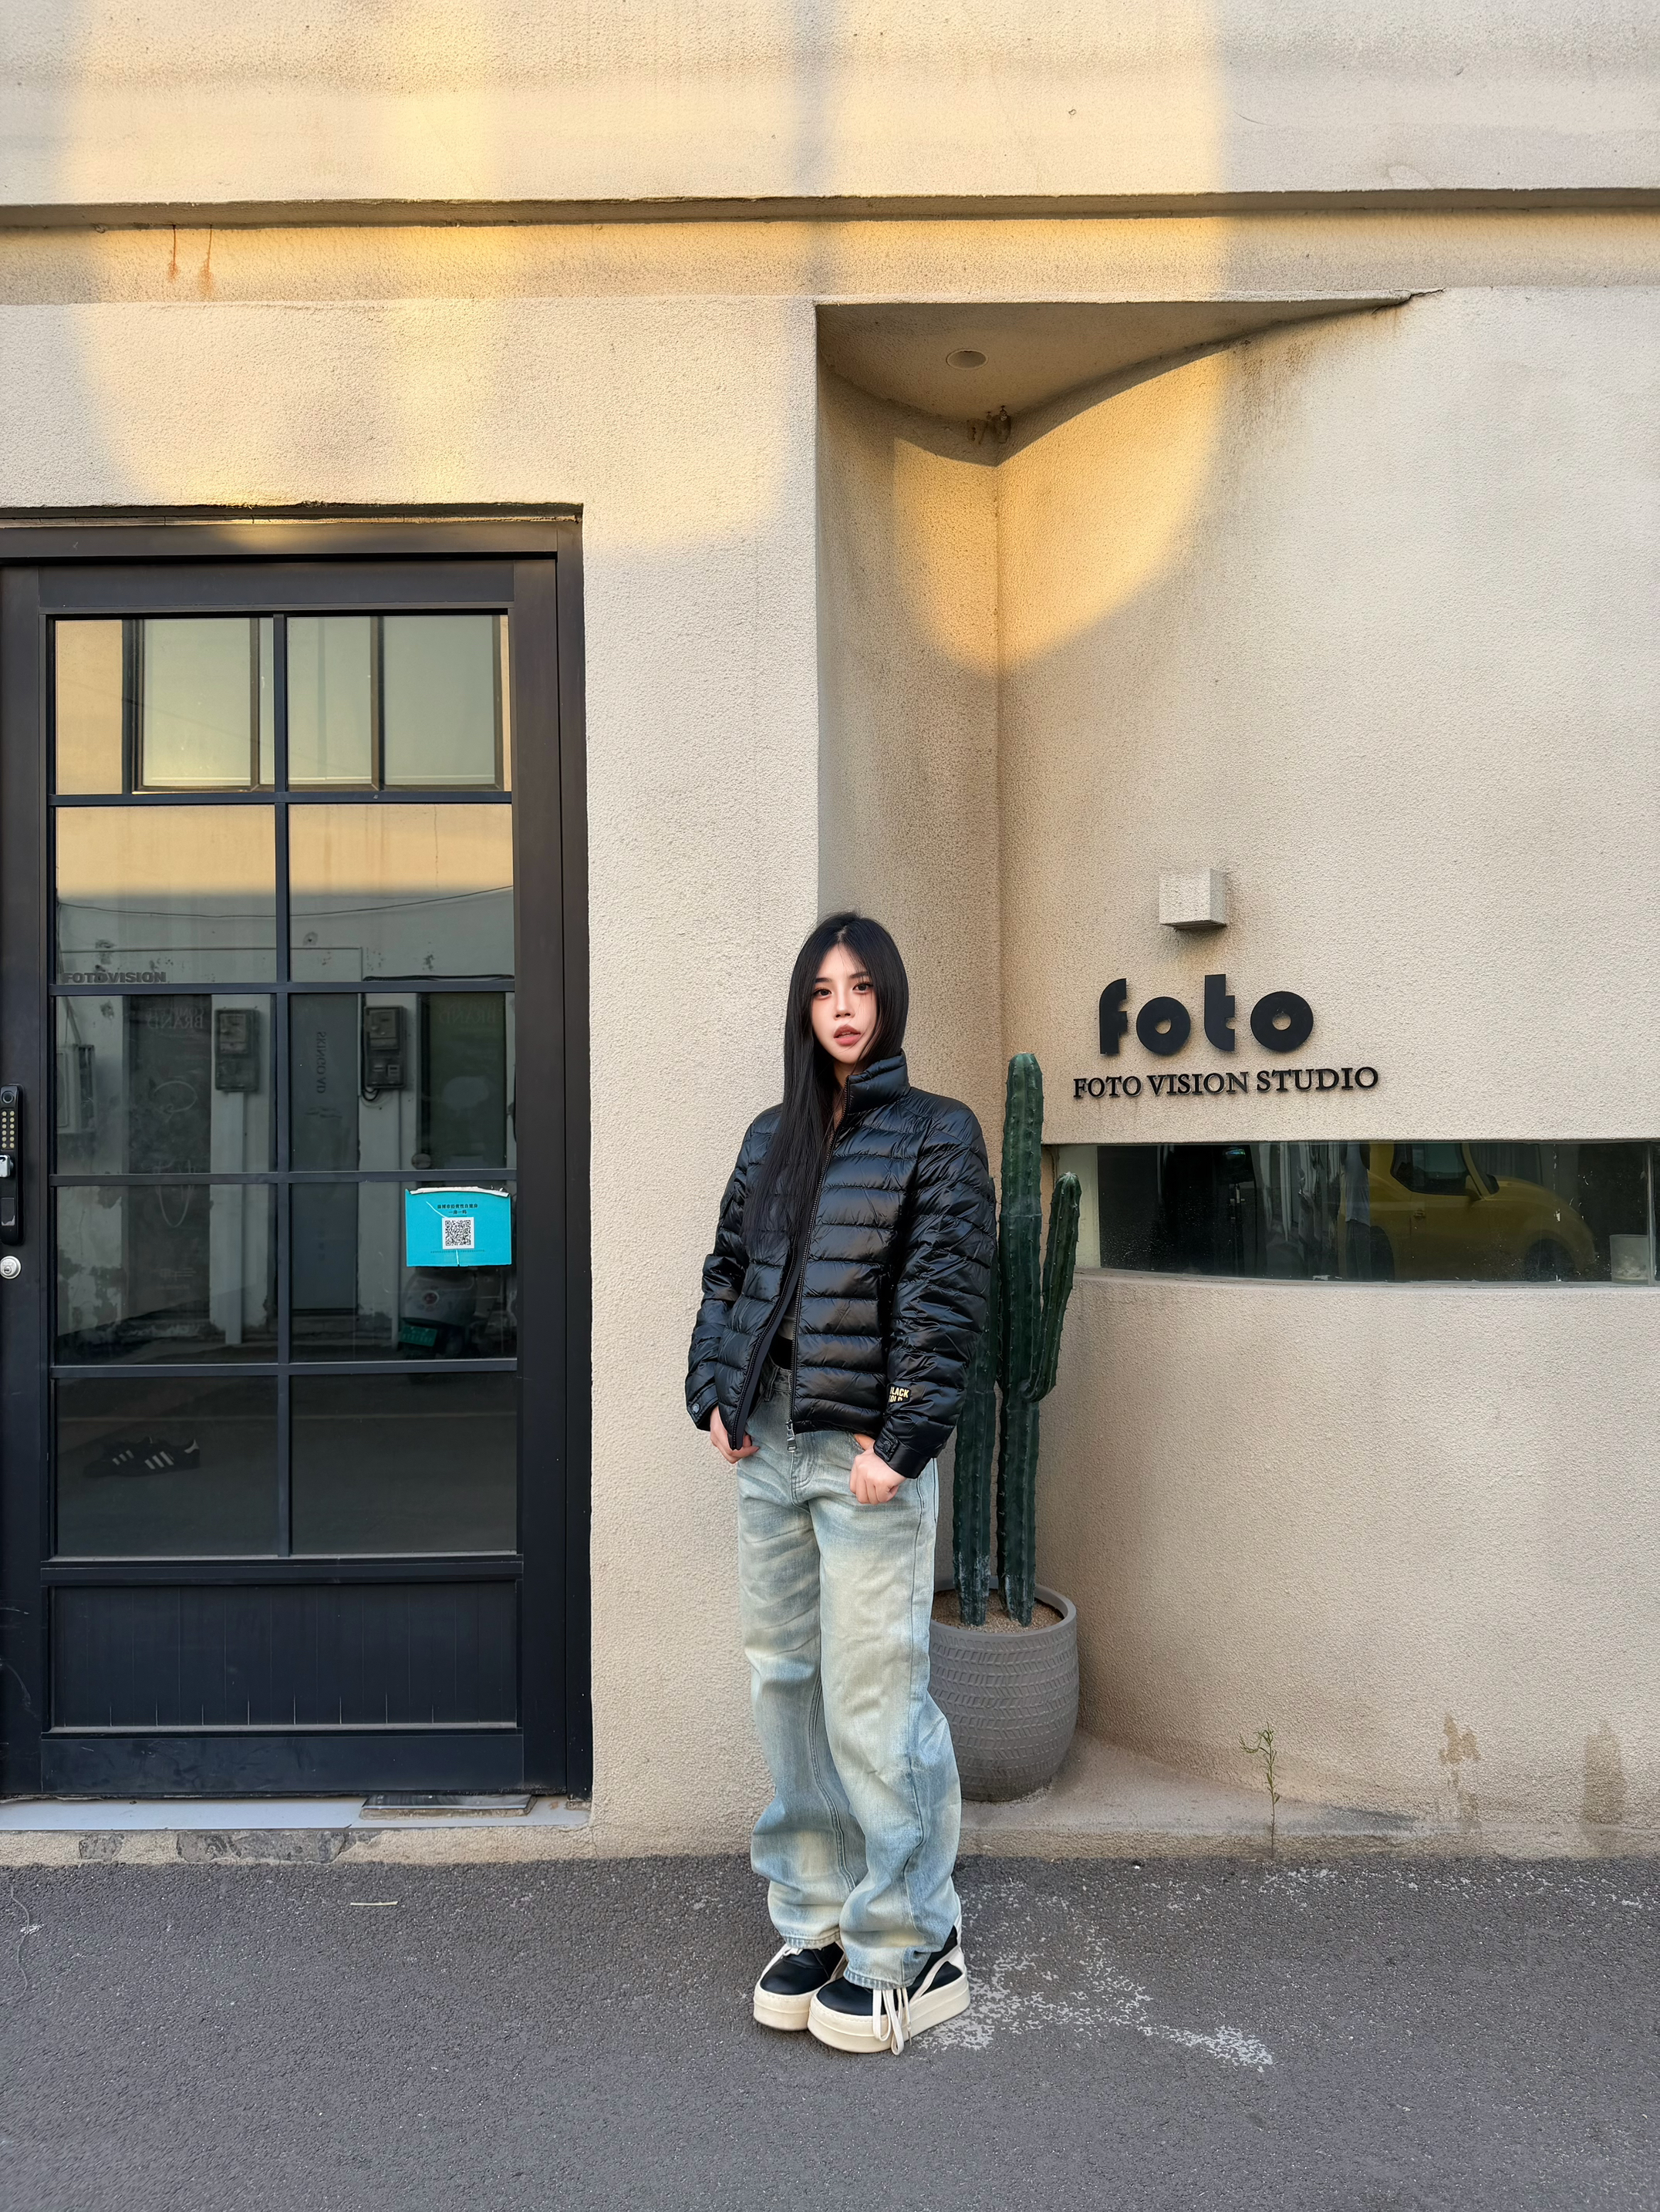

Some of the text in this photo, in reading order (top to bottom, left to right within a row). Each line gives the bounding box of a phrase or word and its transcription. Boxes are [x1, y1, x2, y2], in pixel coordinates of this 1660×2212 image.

[62, 972, 167, 983] FOTOVISION
[1099, 974, 1314, 1055] foto
[1073, 1066, 1379, 1099] FOTO VISION STUDIO
